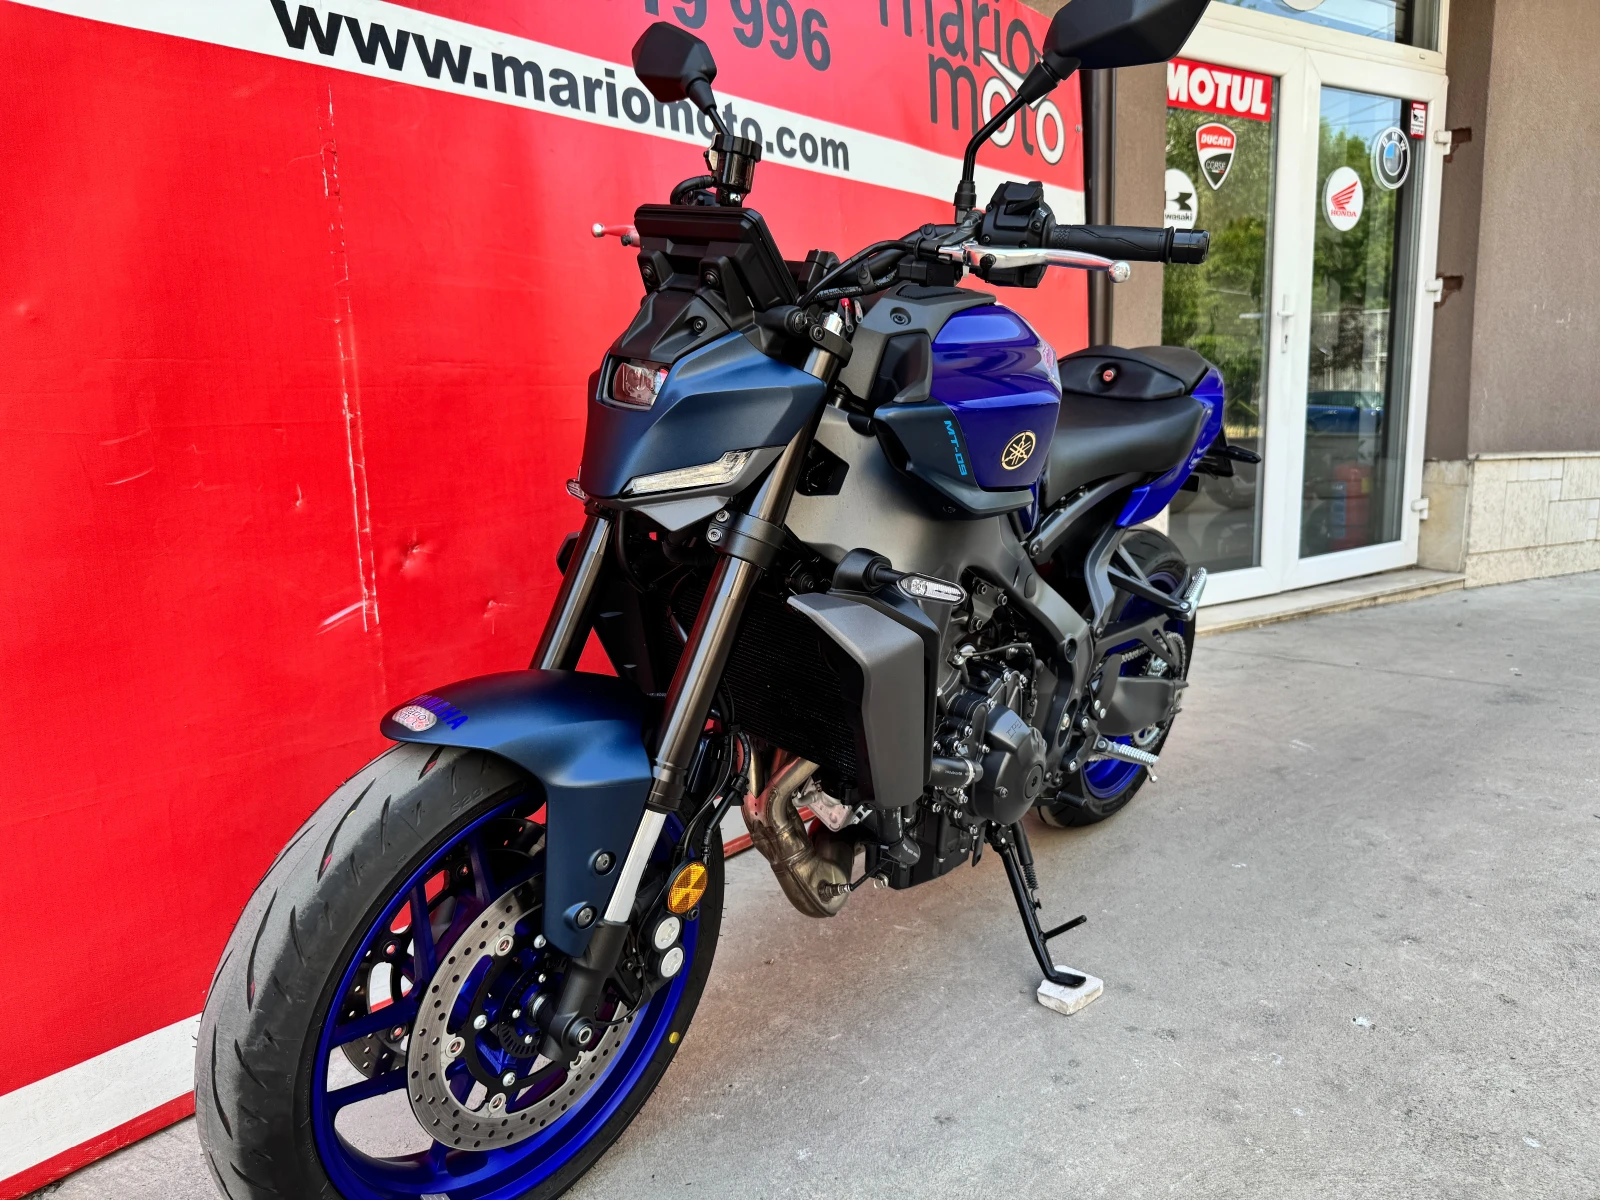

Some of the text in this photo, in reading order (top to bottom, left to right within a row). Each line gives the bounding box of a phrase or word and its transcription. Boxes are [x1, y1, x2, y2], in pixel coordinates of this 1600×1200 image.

[730, 0, 831, 72] 996
[1167, 62, 1267, 116] MOTUL
[1200, 133, 1232, 148] DUCATI
[1381, 132, 1407, 152] BMW
[1205, 160, 1226, 171] CORSE
[1164, 212, 1193, 222] wasaki
[1330, 209, 1357, 218] HONDA
[943, 420, 968, 476] MT-09
